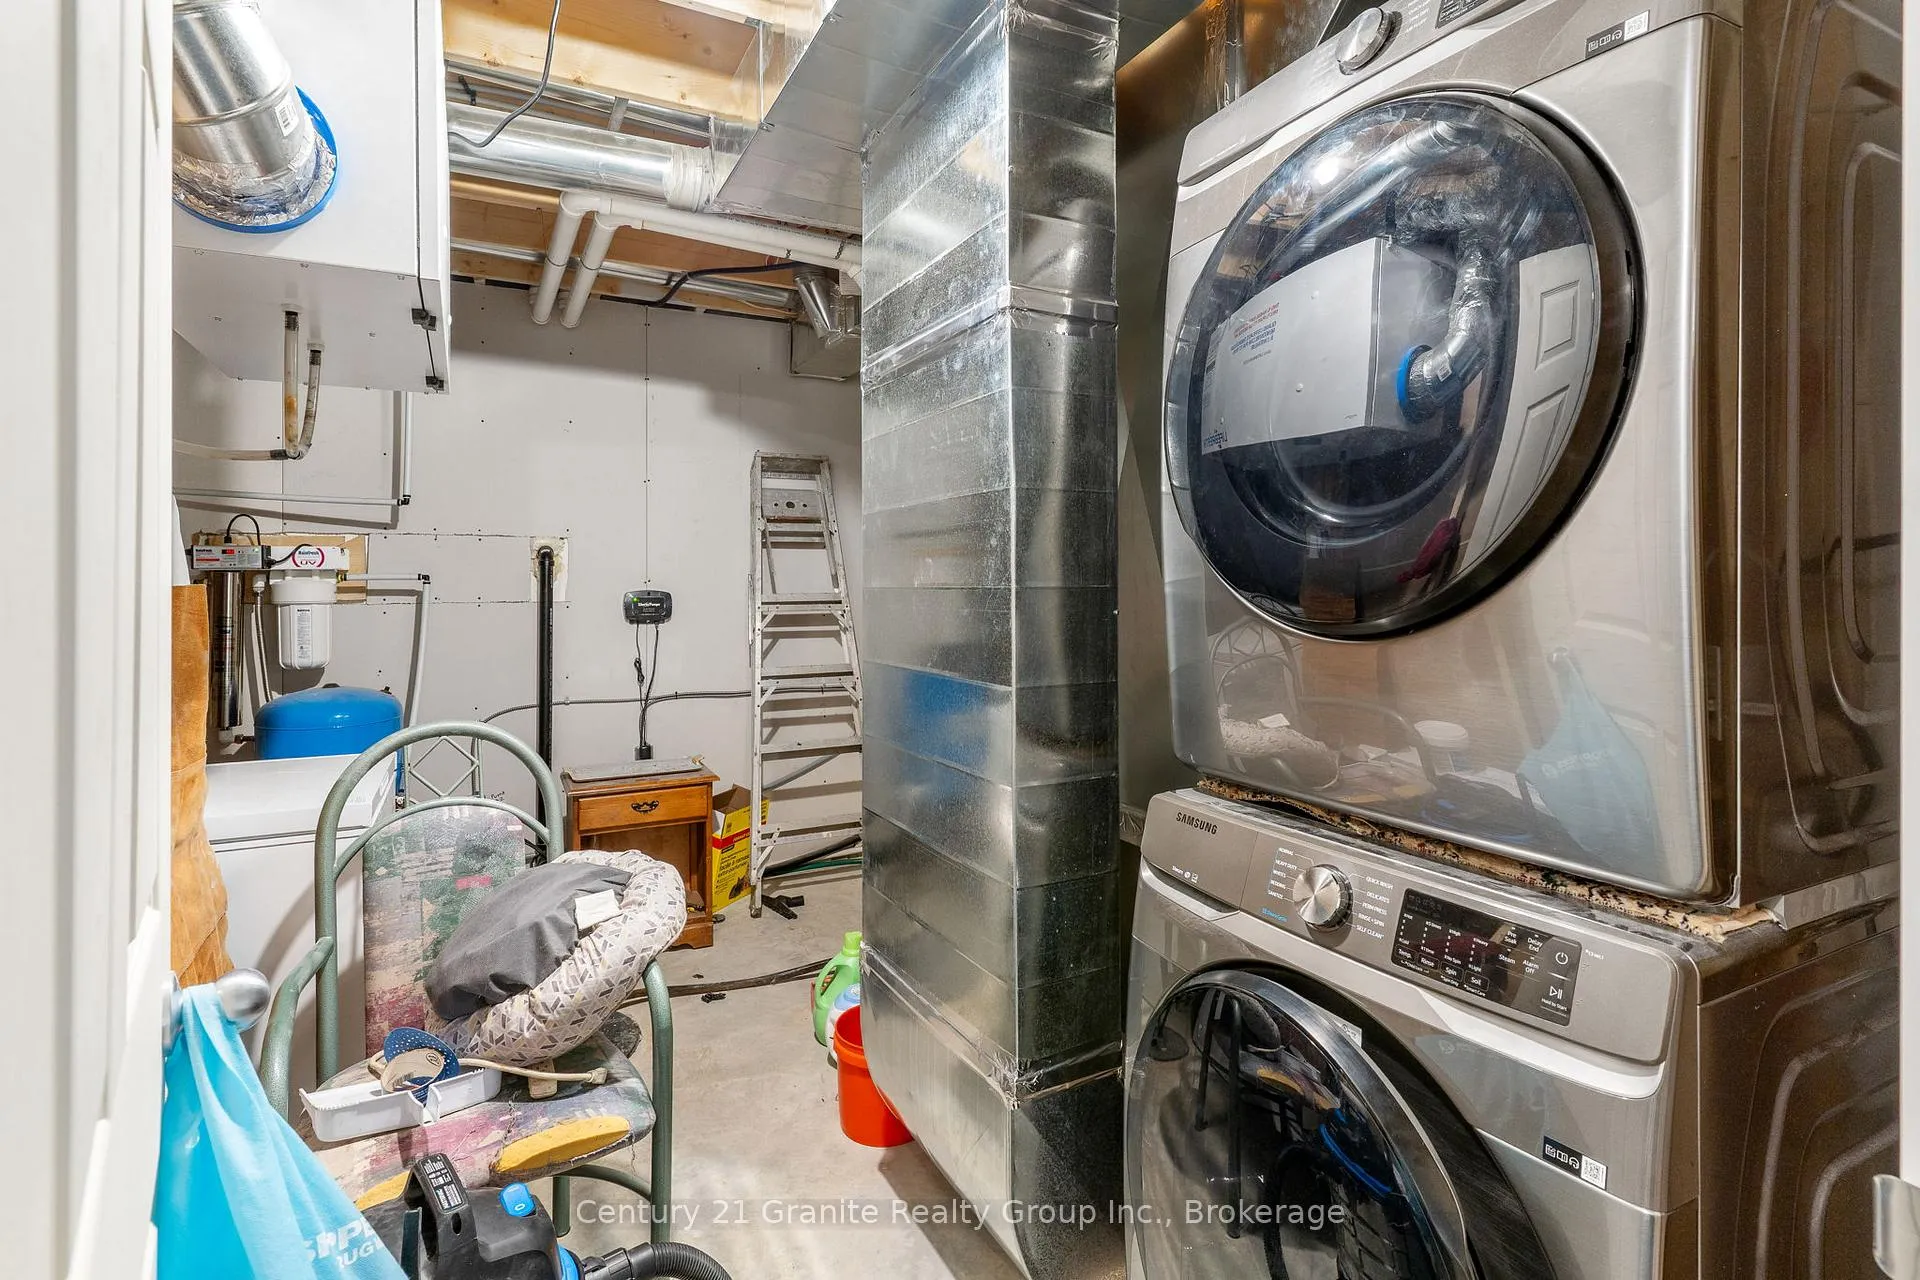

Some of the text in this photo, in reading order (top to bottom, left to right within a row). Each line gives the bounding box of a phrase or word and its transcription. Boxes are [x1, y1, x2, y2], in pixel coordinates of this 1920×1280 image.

[1176, 812, 1218, 834] SAMSUNG
[1508, 931, 1517, 939] Pre
[1504, 936, 1518, 945] Soak
[1527, 938, 1543, 948] Delay
[1498, 954, 1516, 964] Steam
[1522, 960, 1540, 970] Alarm
[1446, 967, 1457, 976] Spin
[1471, 976, 1482, 986] Soil
